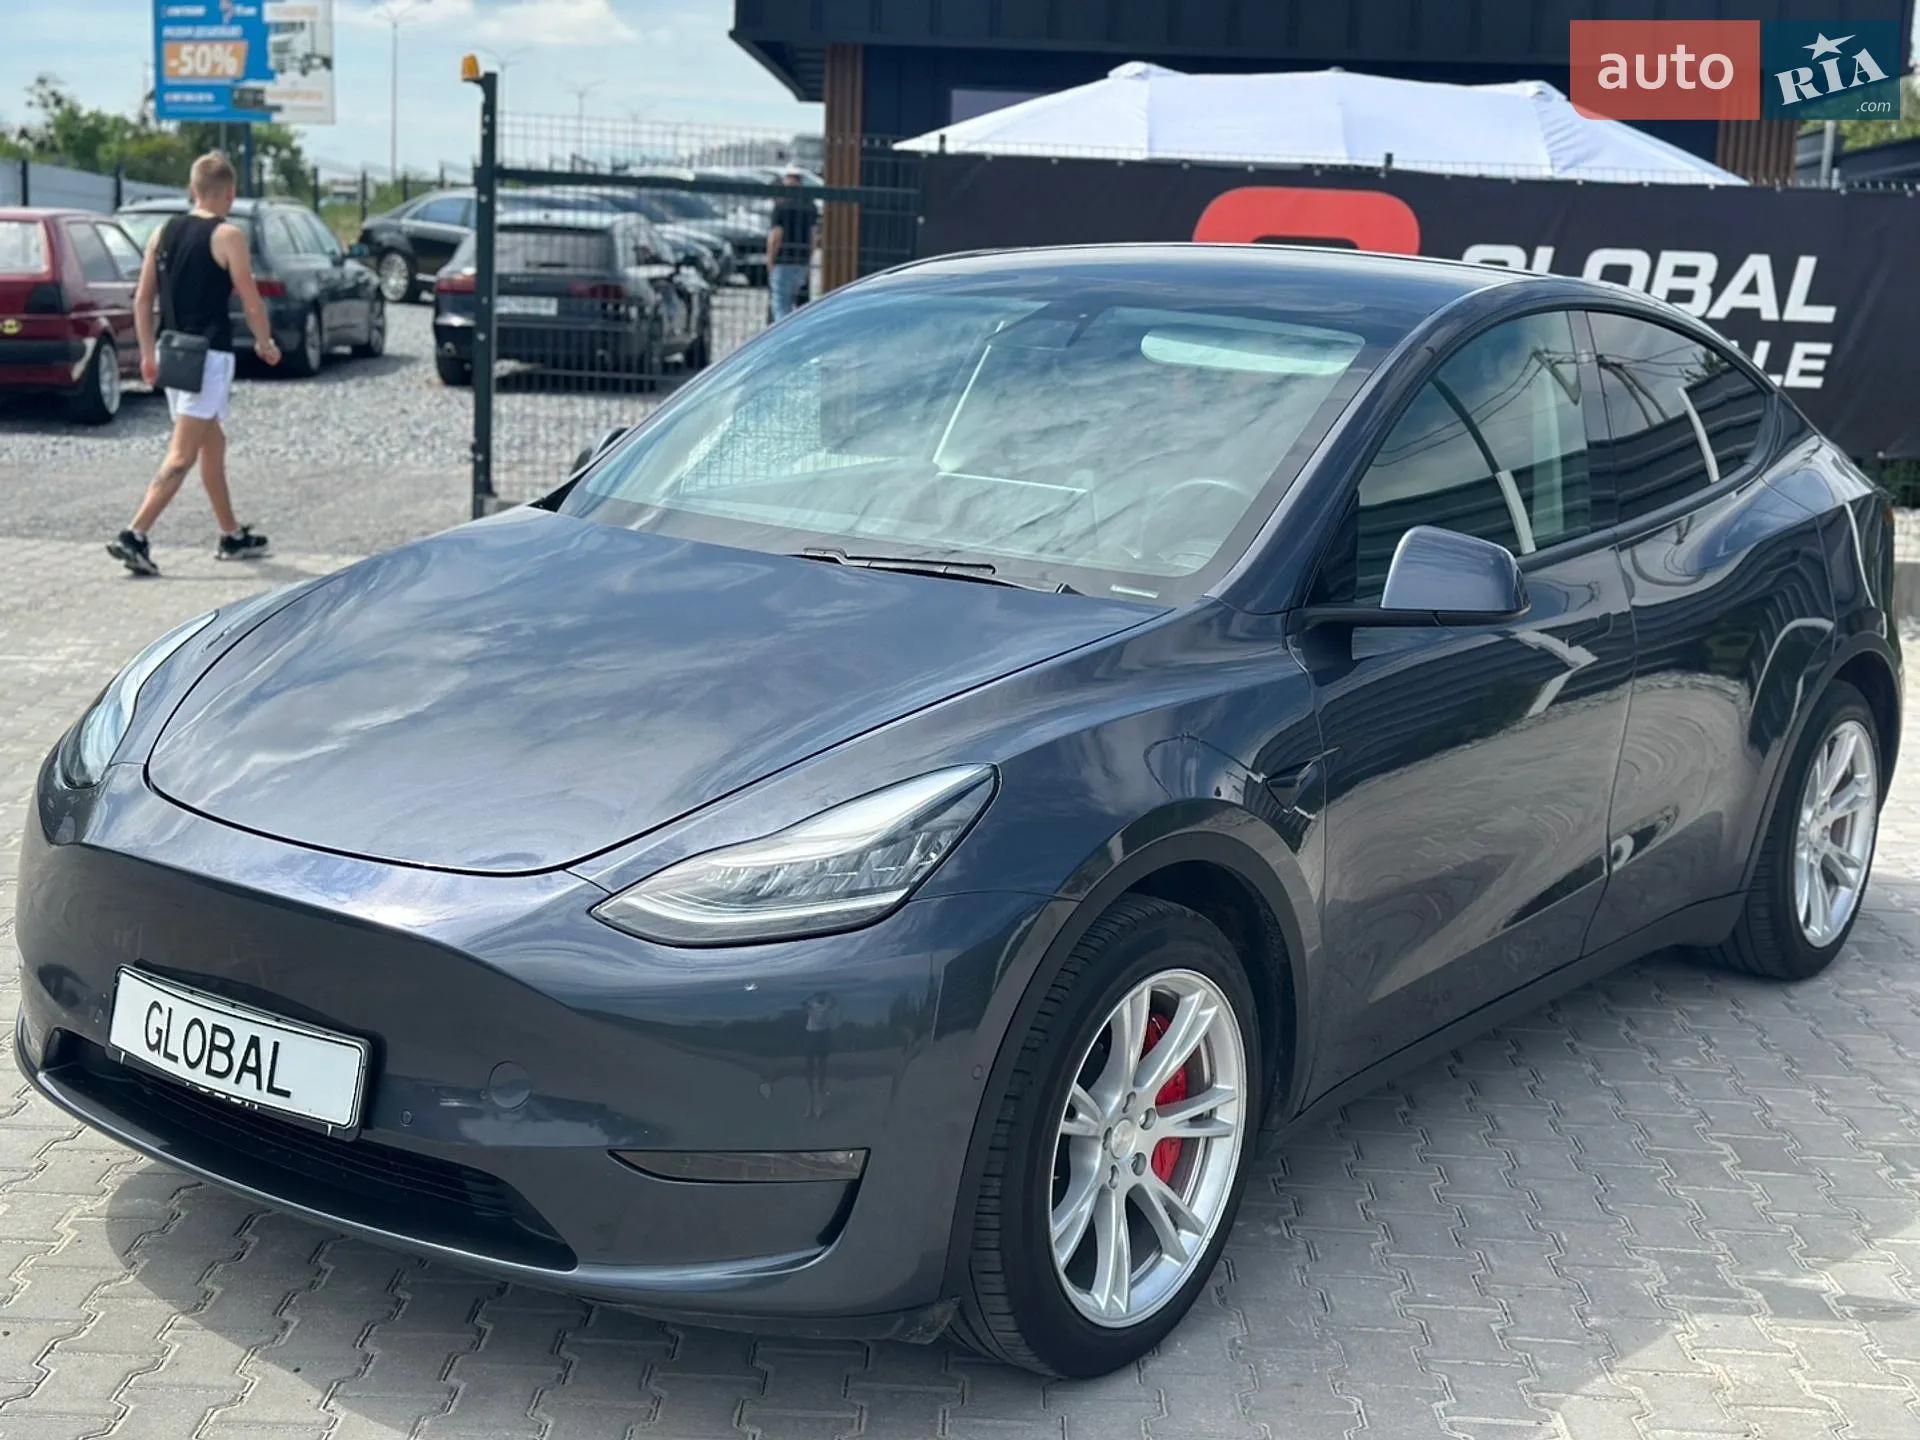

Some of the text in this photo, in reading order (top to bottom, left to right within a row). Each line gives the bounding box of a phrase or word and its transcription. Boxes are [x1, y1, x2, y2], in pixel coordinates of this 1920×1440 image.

[168, 44, 239, 76] -50%
[1729, 339, 1833, 389] LE
[144, 1000, 292, 1098] GLOBAL
